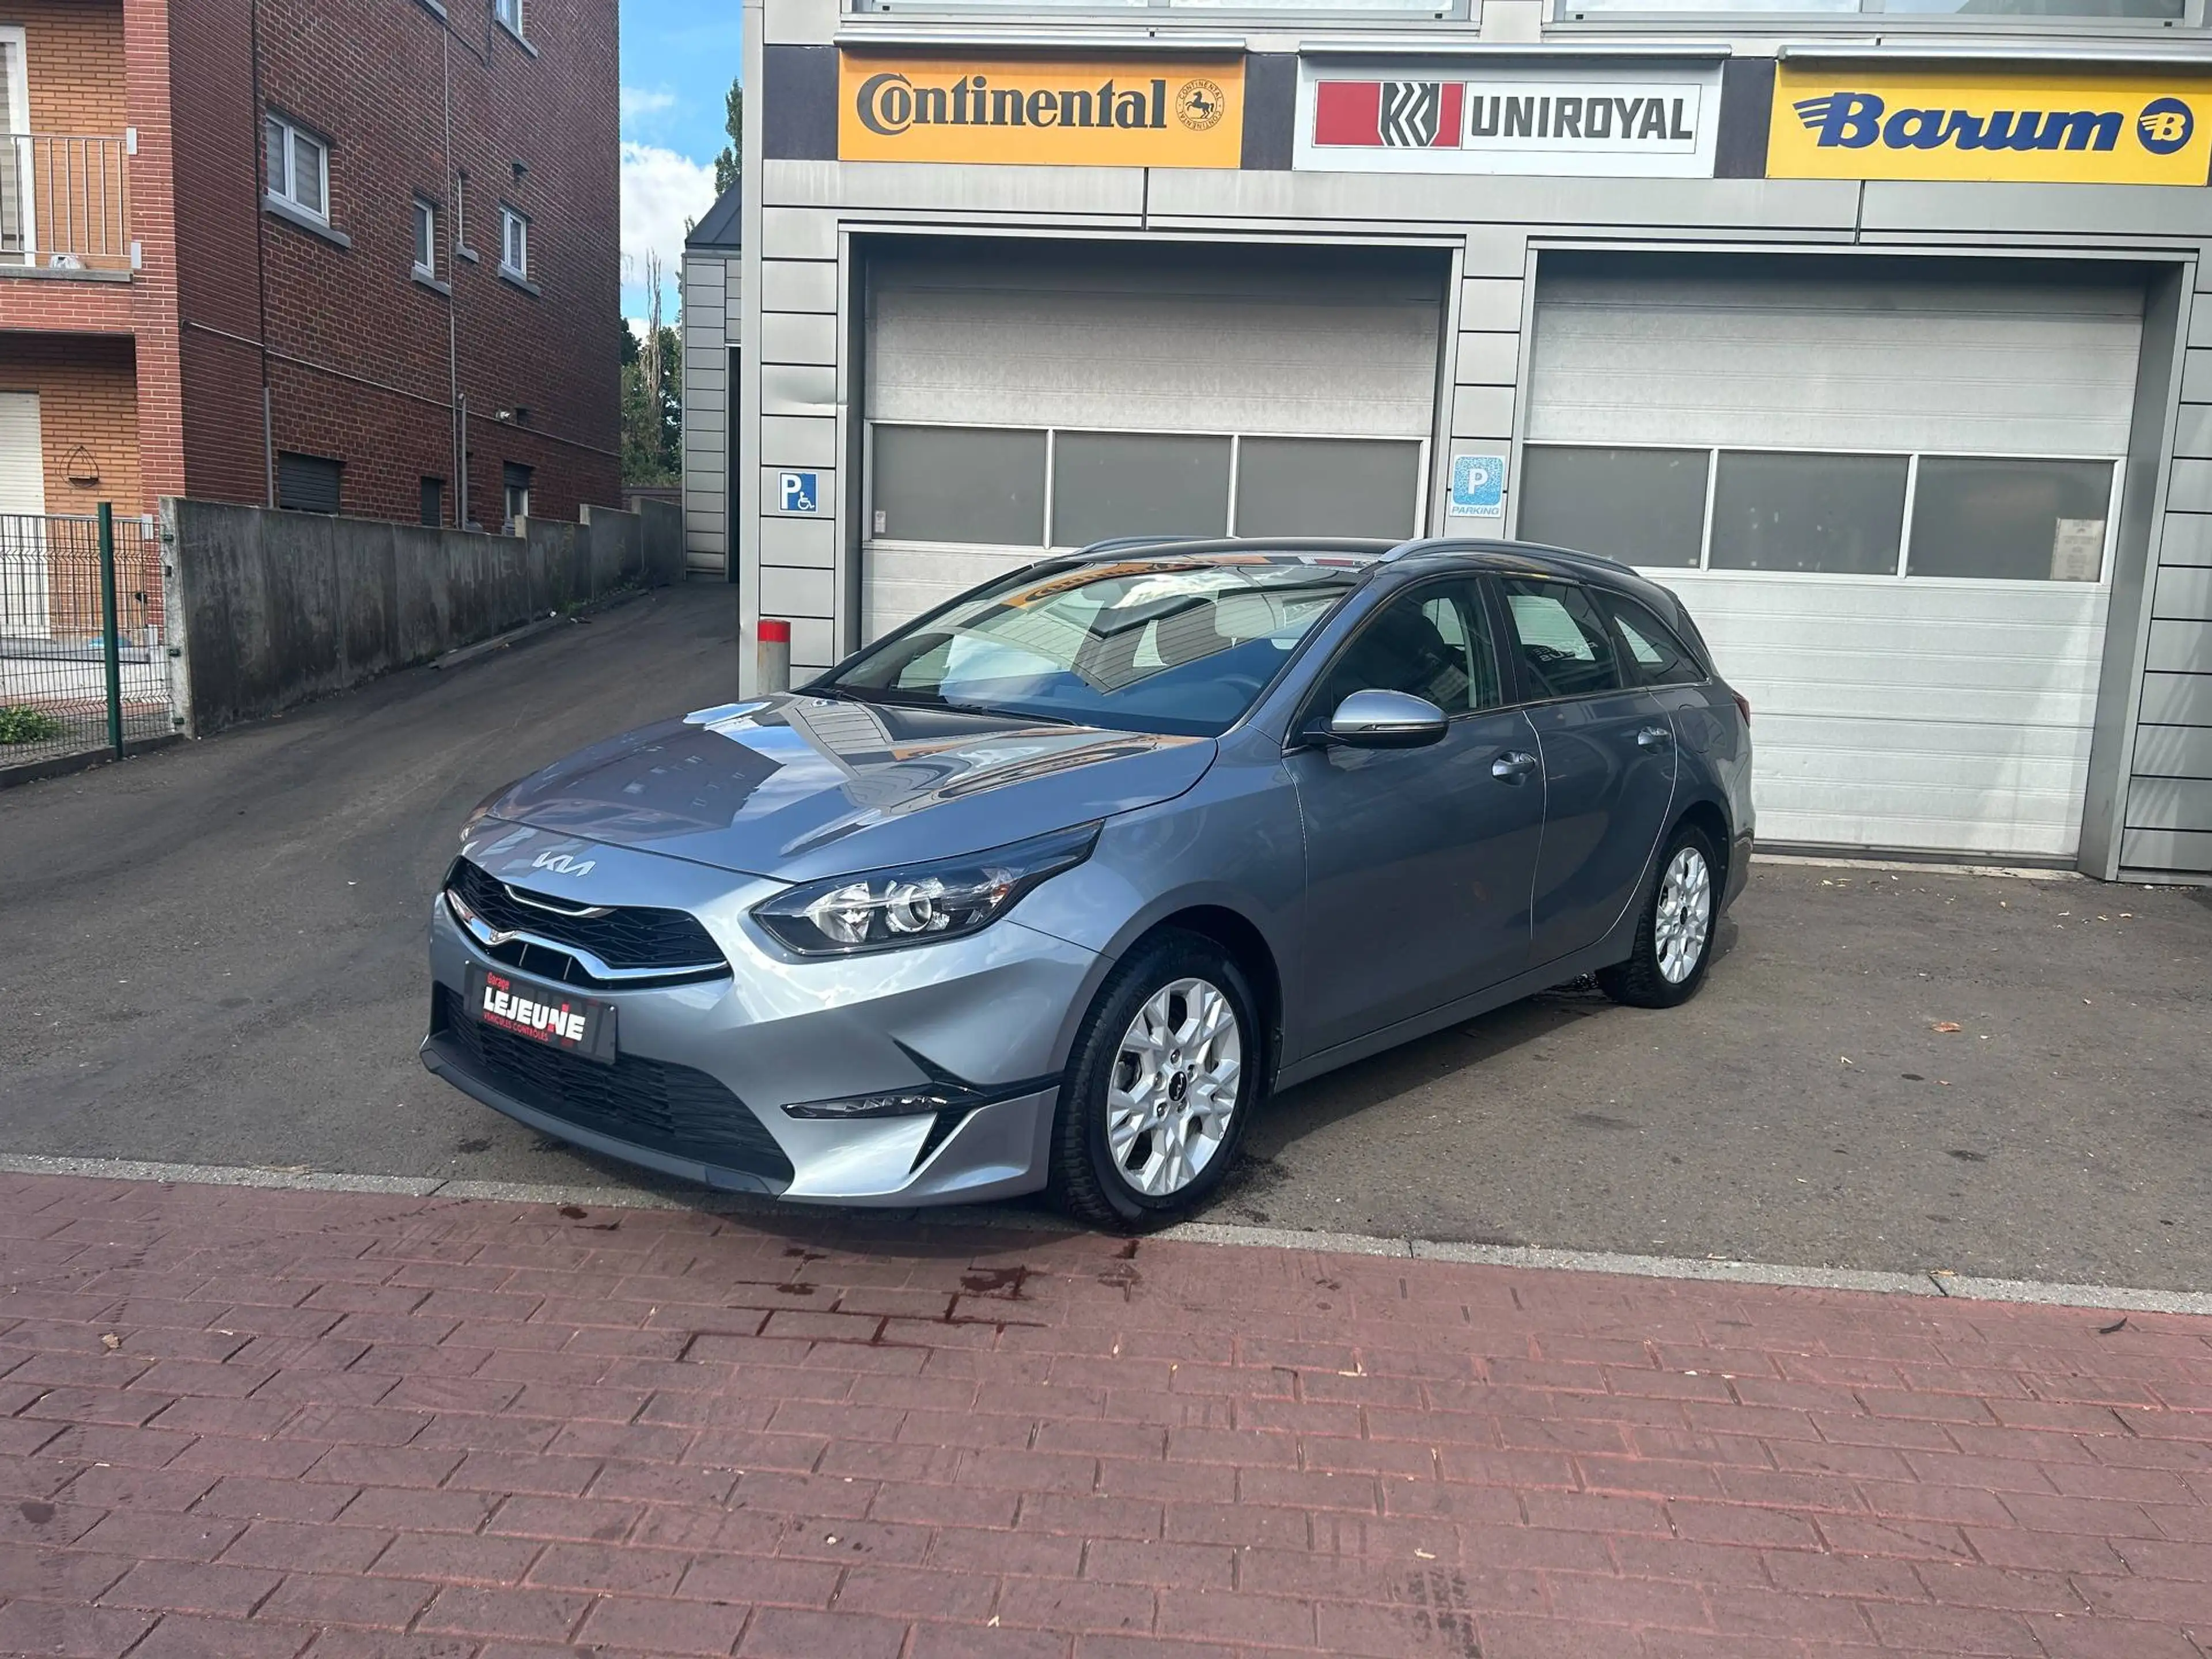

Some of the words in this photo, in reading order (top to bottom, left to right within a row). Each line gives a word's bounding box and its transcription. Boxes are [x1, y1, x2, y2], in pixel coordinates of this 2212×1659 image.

[857, 73, 1167, 135] Continental
[1178, 80, 1222, 99] CONTINENTAL
[1471, 96, 1693, 139] UNIROYAL
[1793, 92, 2124, 151] Barum
[781, 474, 801, 509] P
[1468, 468, 1488, 494] P
[1451, 506, 1501, 515] PARKING
[483, 986, 586, 1041] LEJEUNE
